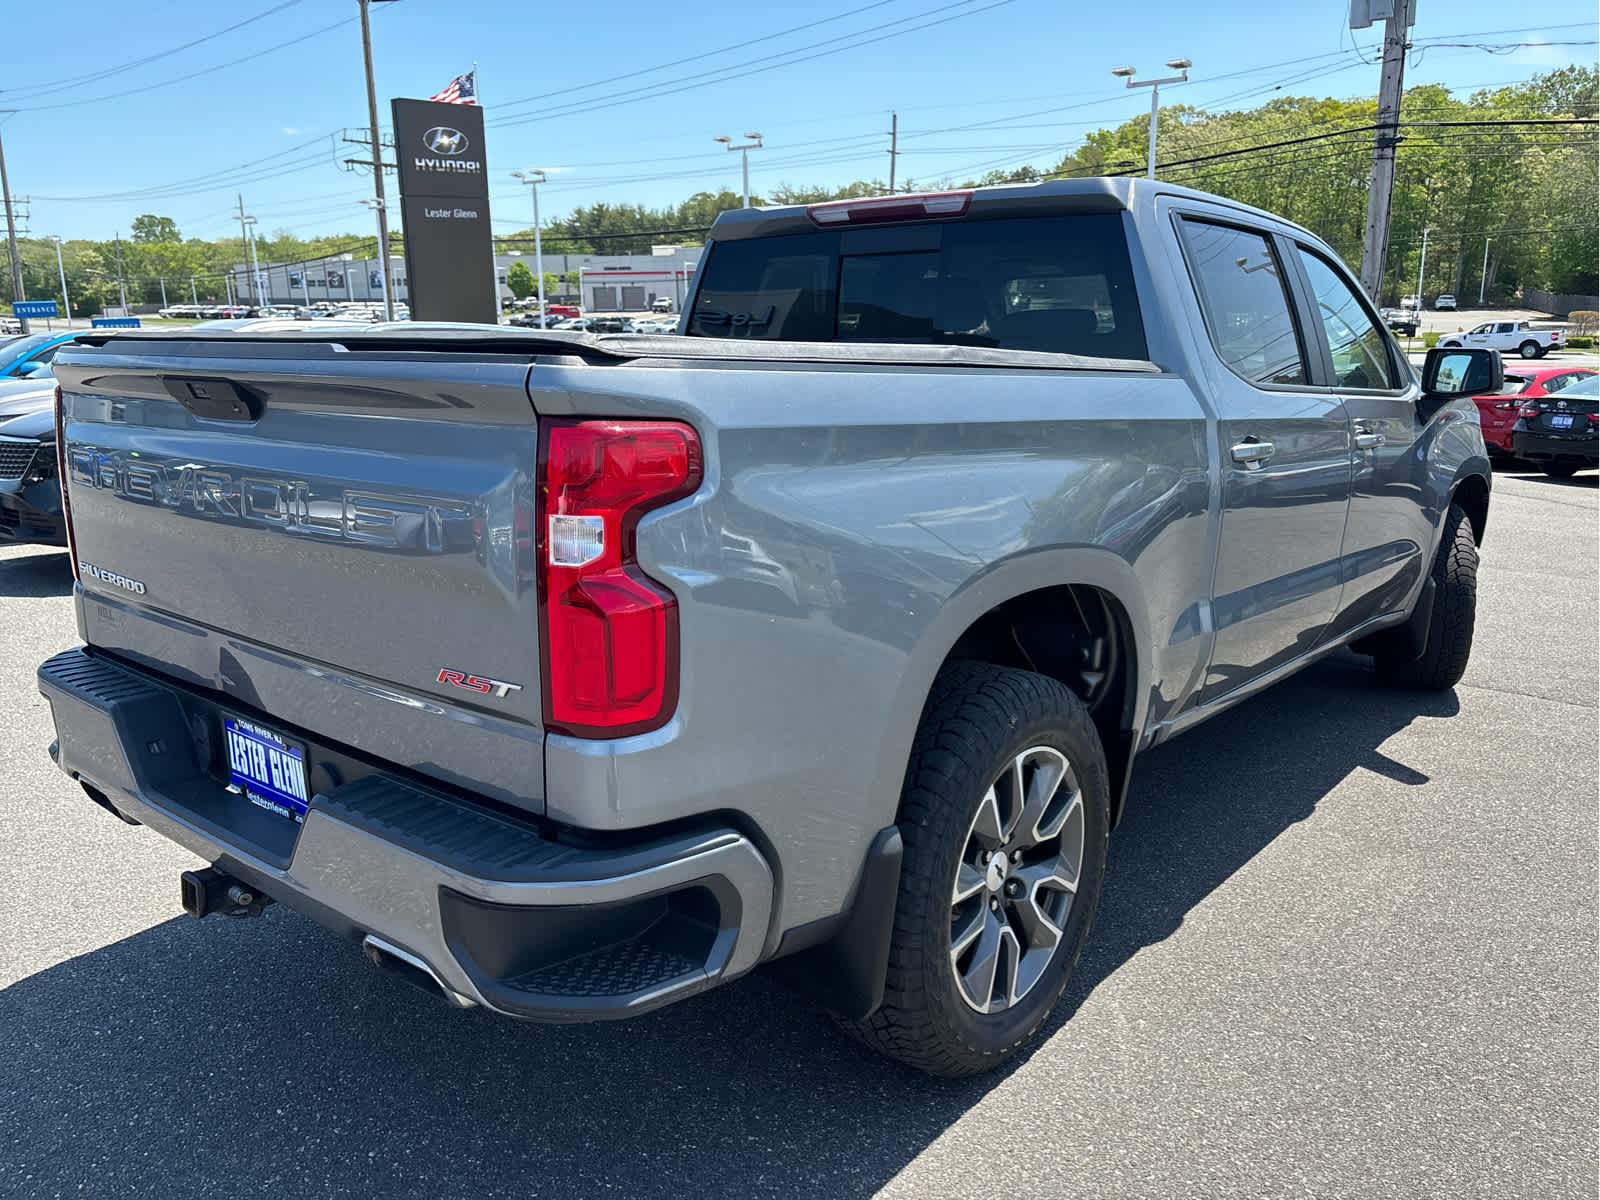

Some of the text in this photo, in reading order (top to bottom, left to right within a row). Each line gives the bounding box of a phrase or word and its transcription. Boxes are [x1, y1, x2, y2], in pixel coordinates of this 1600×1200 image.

[415, 157, 481, 173] HYUNDAI
[424, 207, 478, 219] Lester Glenn
[16, 306, 56, 314] ENTRANCE
[71, 447, 471, 552] CHEVROLET
[79, 561, 146, 595] SILVERADO
[436, 667, 524, 698] RST
[237, 719, 254, 734] TOMS
[227, 730, 308, 803] LESTER GLENN
